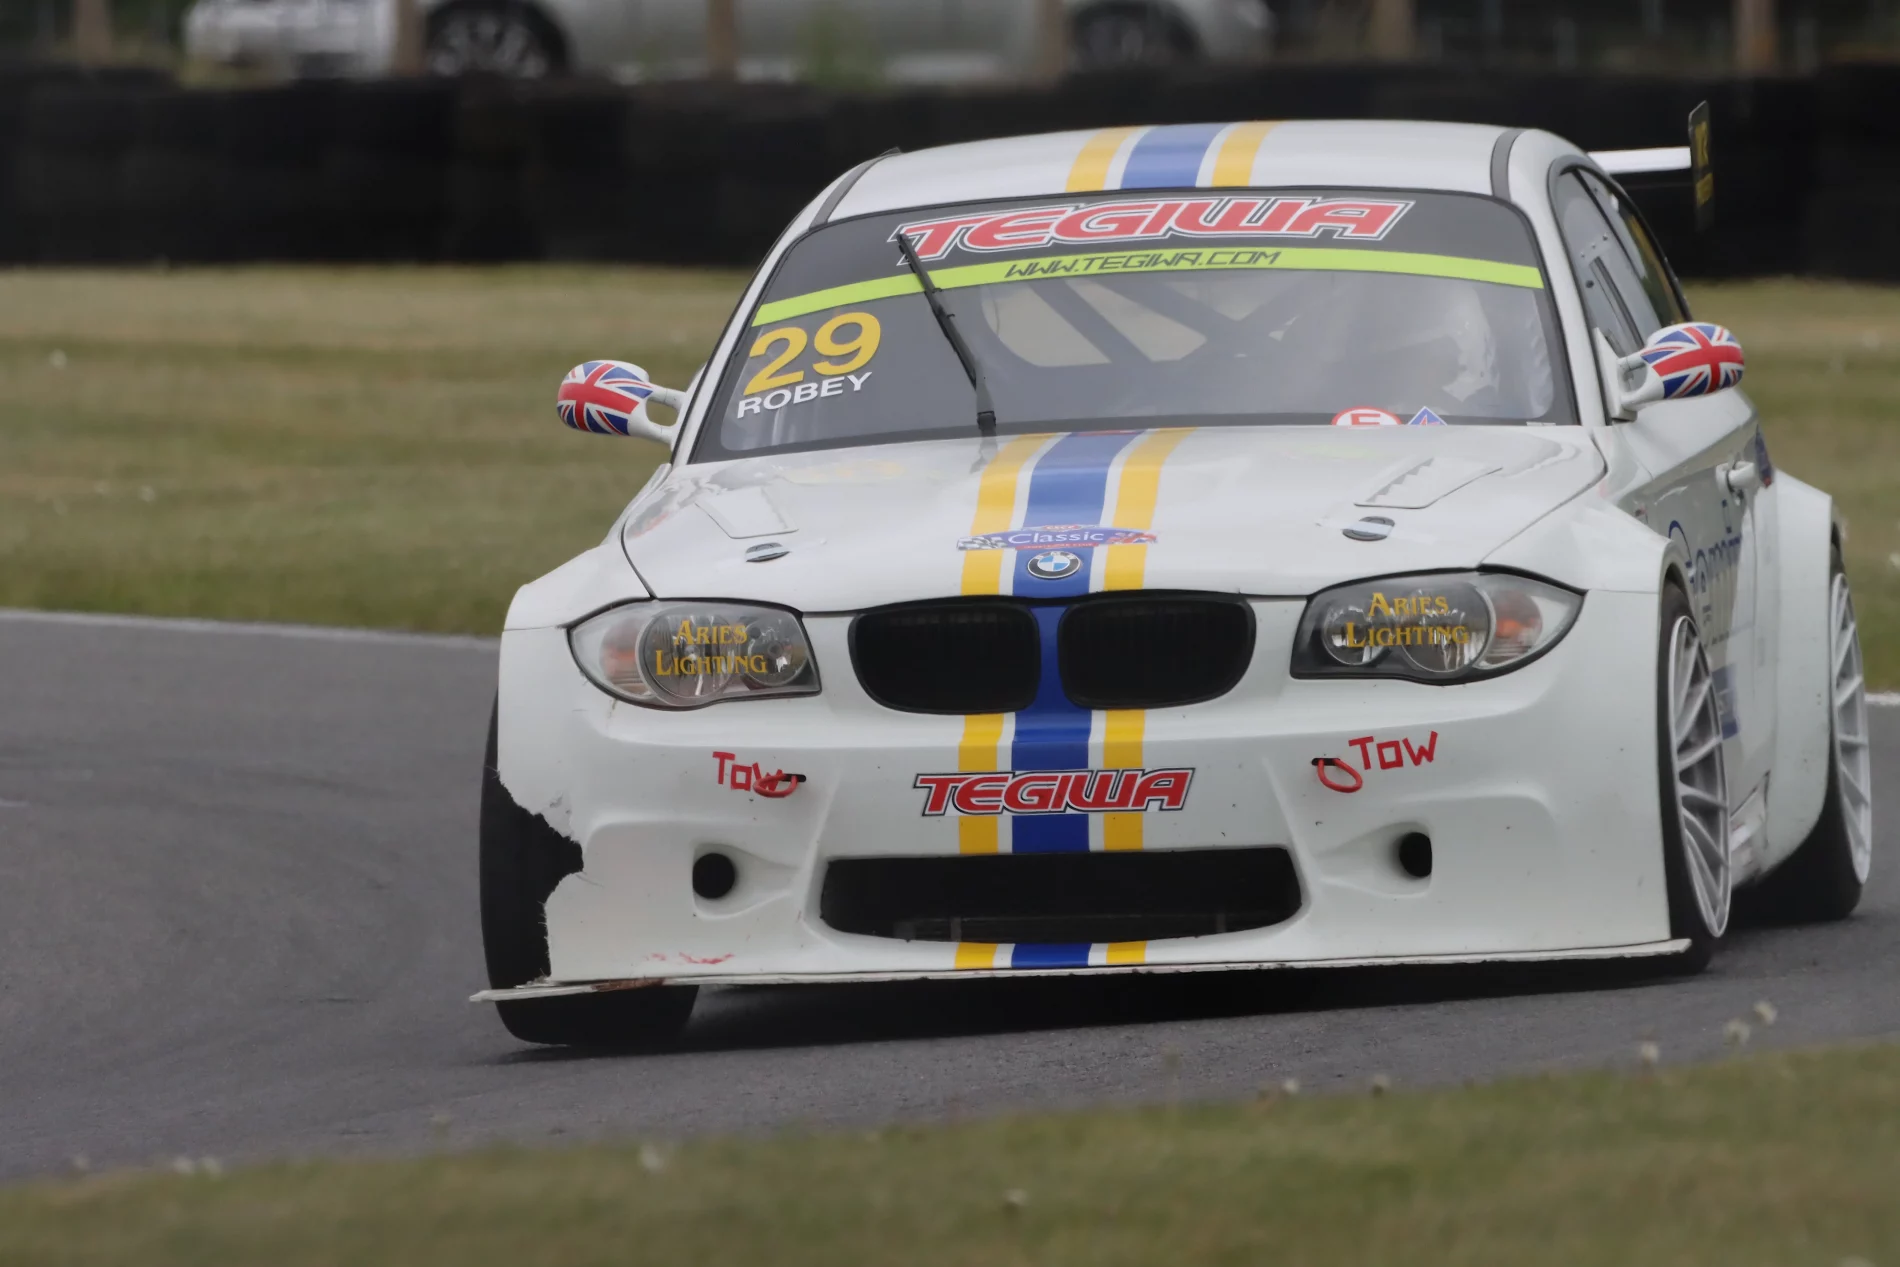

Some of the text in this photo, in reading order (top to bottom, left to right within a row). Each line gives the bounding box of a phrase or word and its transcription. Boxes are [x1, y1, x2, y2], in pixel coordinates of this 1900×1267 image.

[889, 197, 1415, 265] TEGIWA
[1004, 251, 1282, 278] WWW.TEGIWA.COM
[743, 312, 881, 396] 29
[736, 372, 873, 418] ROBEY
[1008, 531, 1105, 544] Classic
[1368, 592, 1449, 617] ARIES
[674, 619, 748, 646] ARIES
[1345, 621, 1470, 648] LIGHTING
[655, 650, 768, 676] LIGHTING
[913, 768, 1195, 816] TEGIWA
